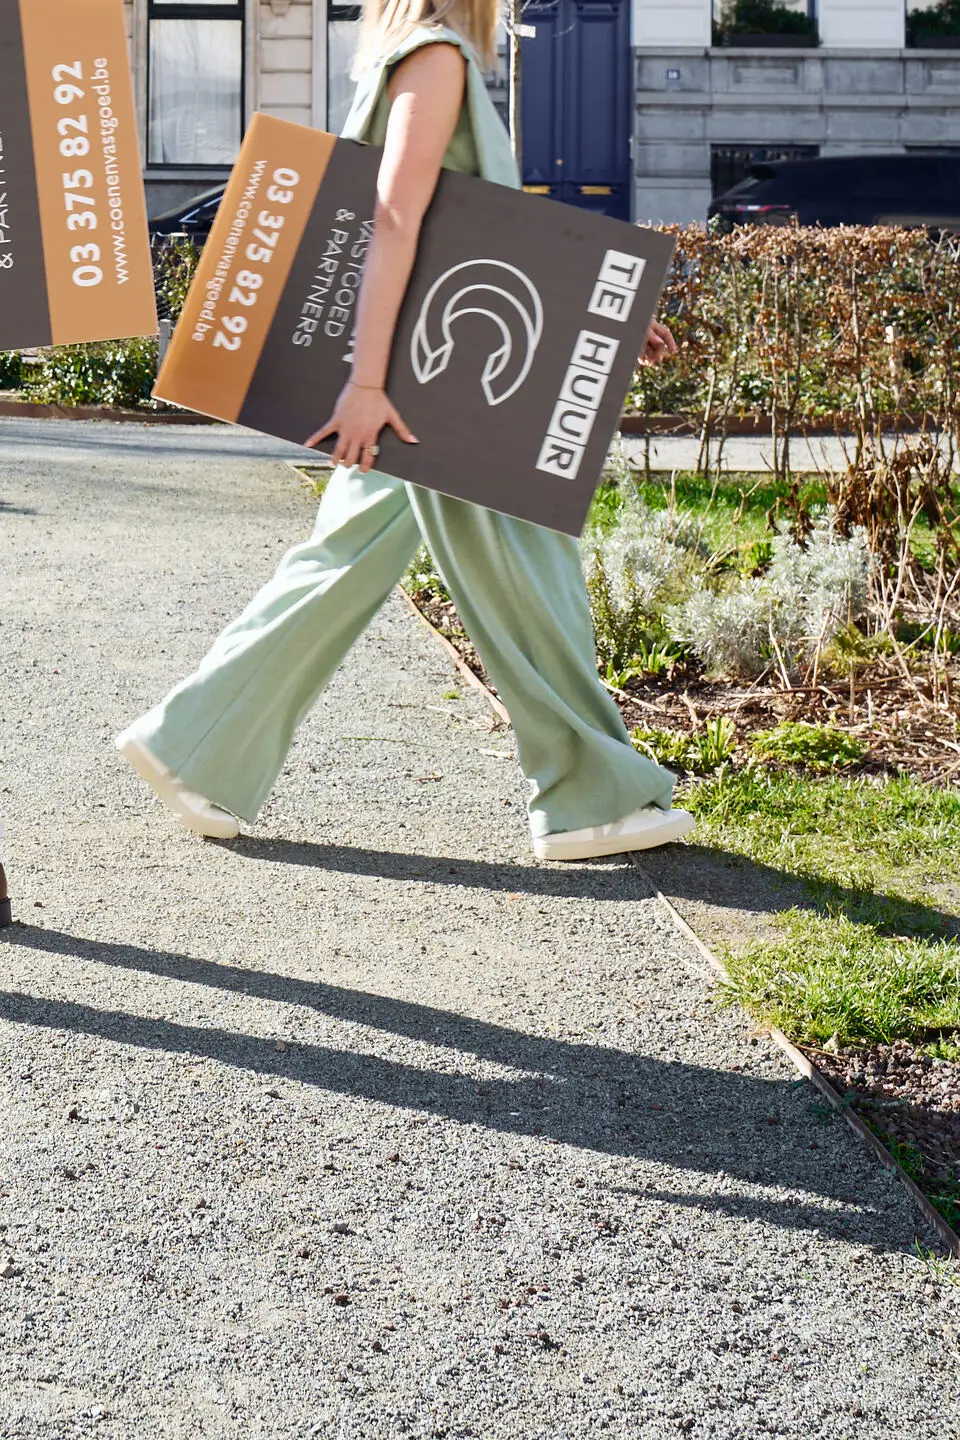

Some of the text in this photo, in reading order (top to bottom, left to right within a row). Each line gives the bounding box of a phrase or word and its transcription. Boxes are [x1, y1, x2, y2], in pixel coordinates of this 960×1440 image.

[52, 61, 103, 287] 03 375 82 92
[91, 57, 129, 285] www.coenenvastgoed.be
[192, 160, 268, 342] www.coenenvastgoed.be
[213, 168, 300, 351] 03 375 82 92
[292, 209, 356, 347] & PARTNERS
[542, 260, 641, 472] TE HUUR
